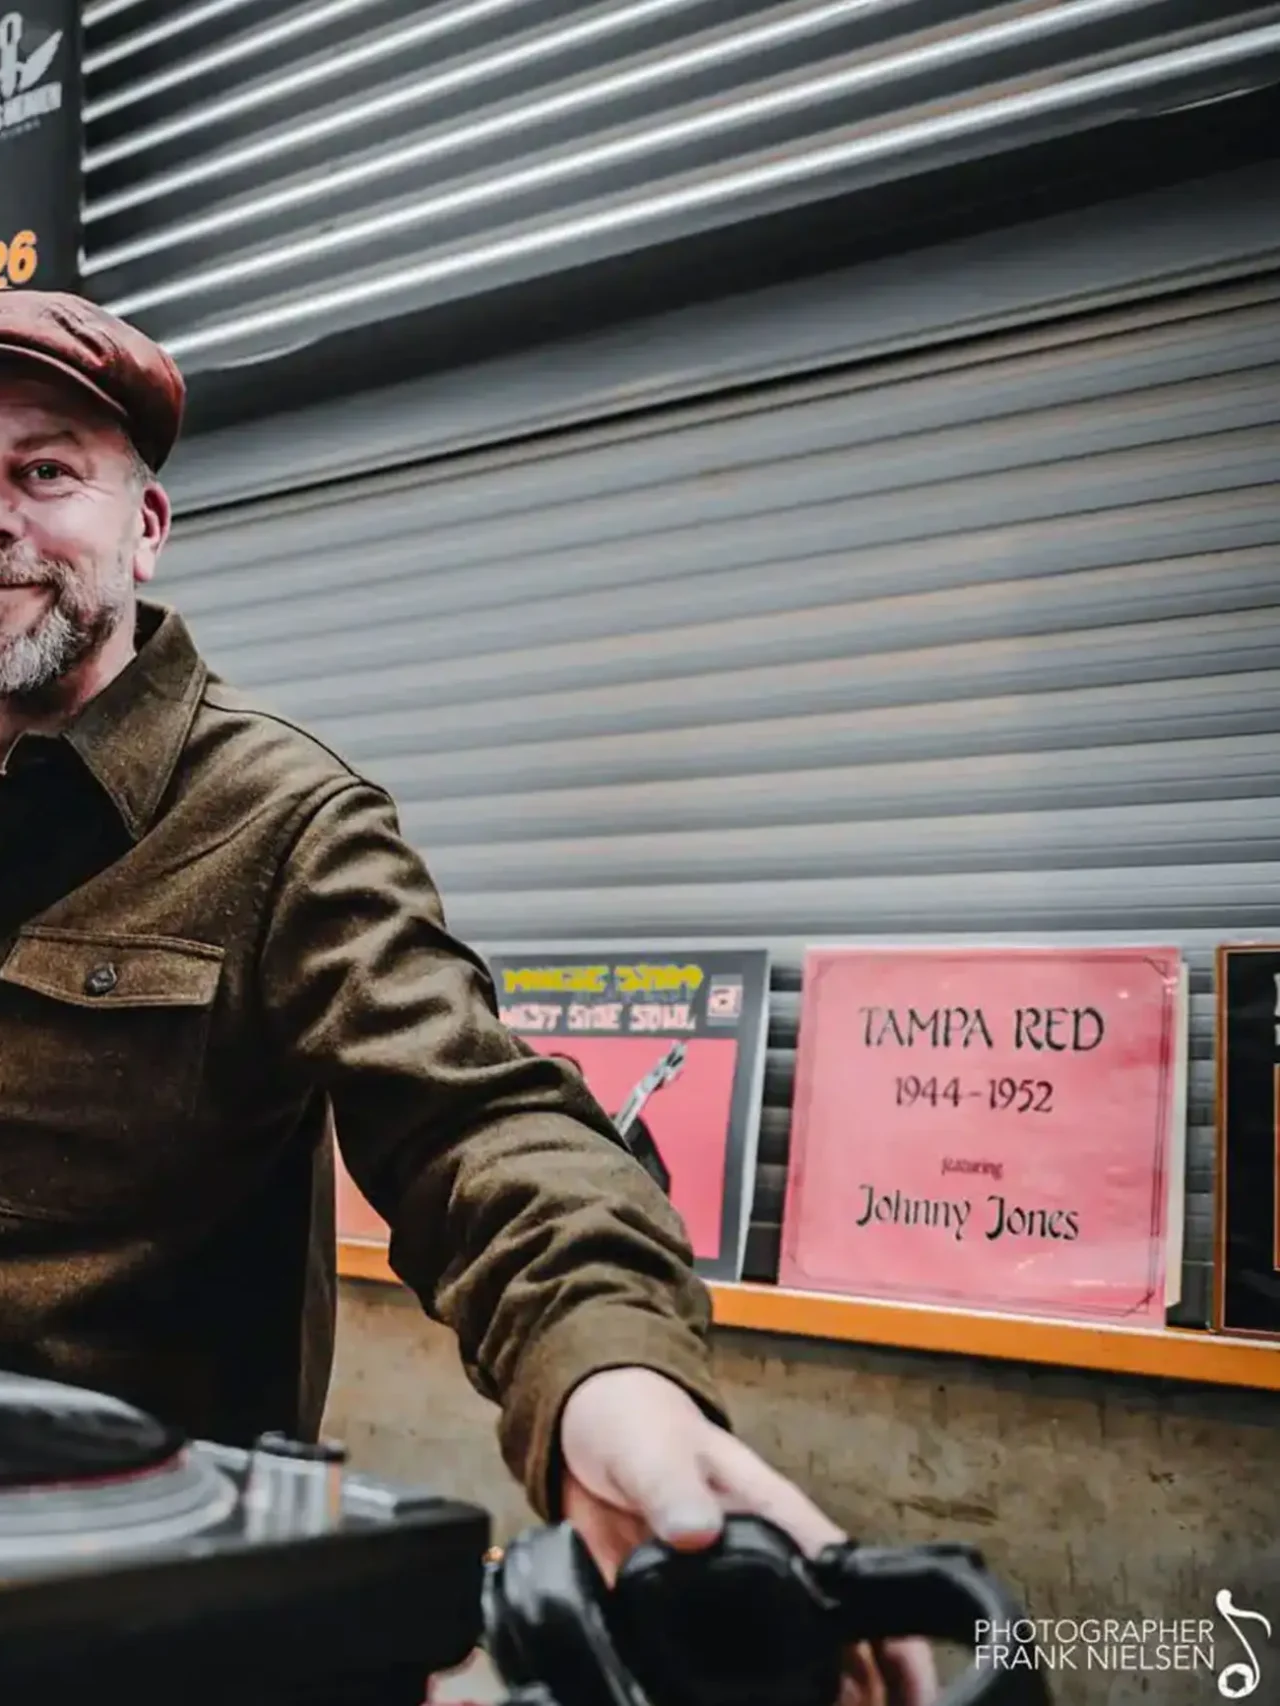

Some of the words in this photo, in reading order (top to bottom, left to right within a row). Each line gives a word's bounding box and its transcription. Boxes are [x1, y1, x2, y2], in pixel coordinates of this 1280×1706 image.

[858, 1005, 994, 1050] TAMPA
[1013, 1005, 1106, 1052] RED
[894, 1075, 1055, 1113] 1944-1952
[855, 1184, 972, 1241] Johnny
[985, 1194, 1081, 1241] Jones
